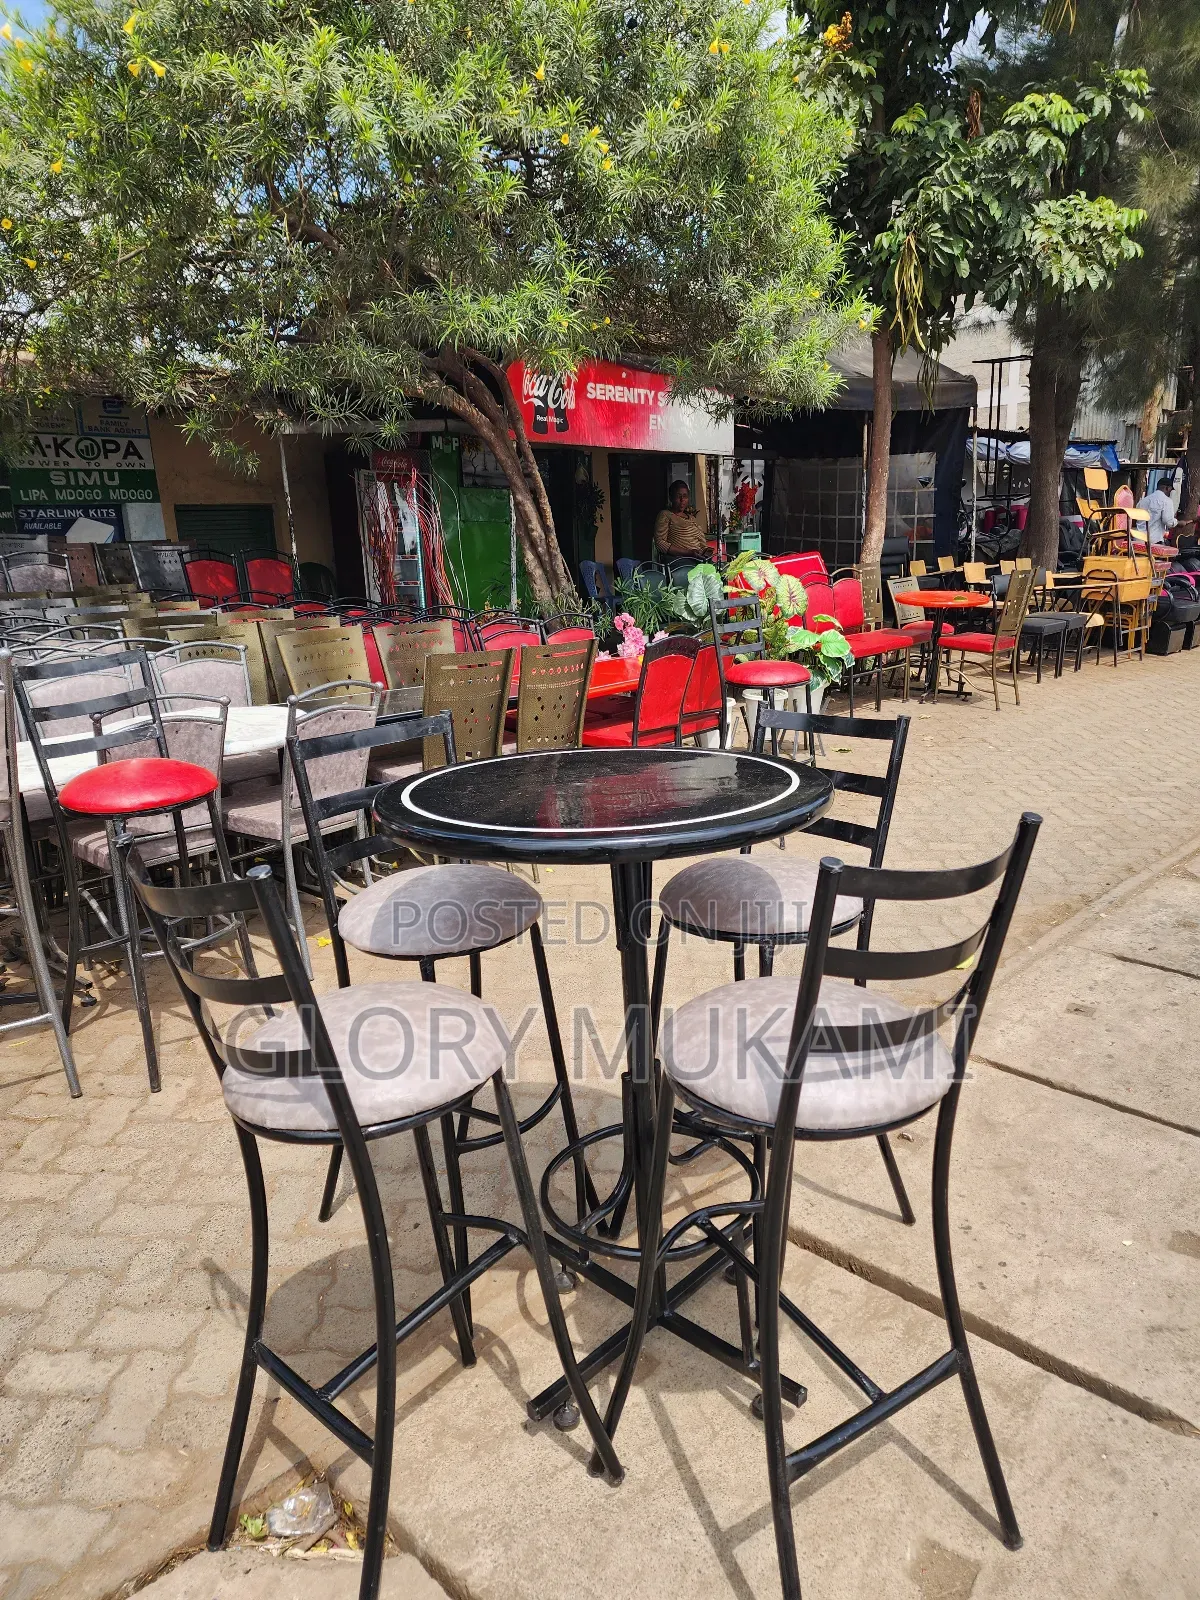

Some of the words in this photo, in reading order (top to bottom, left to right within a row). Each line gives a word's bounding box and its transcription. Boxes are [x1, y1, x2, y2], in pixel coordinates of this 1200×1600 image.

[586, 382, 655, 407] SERENITY
[536, 414, 548, 422] Real
[100, 419, 129, 428] FAMILY
[114, 427, 142, 435] AGENT
[50, 470, 120, 486] SIMU
[20, 489, 48, 501] LIPA
[55, 489, 102, 501] MDOGO
[109, 489, 153, 500] MDOGO
[18, 508, 85, 519] STARLINK
[89, 508, 116, 518] KITS
[23, 522, 62, 530] AVAILABLE
